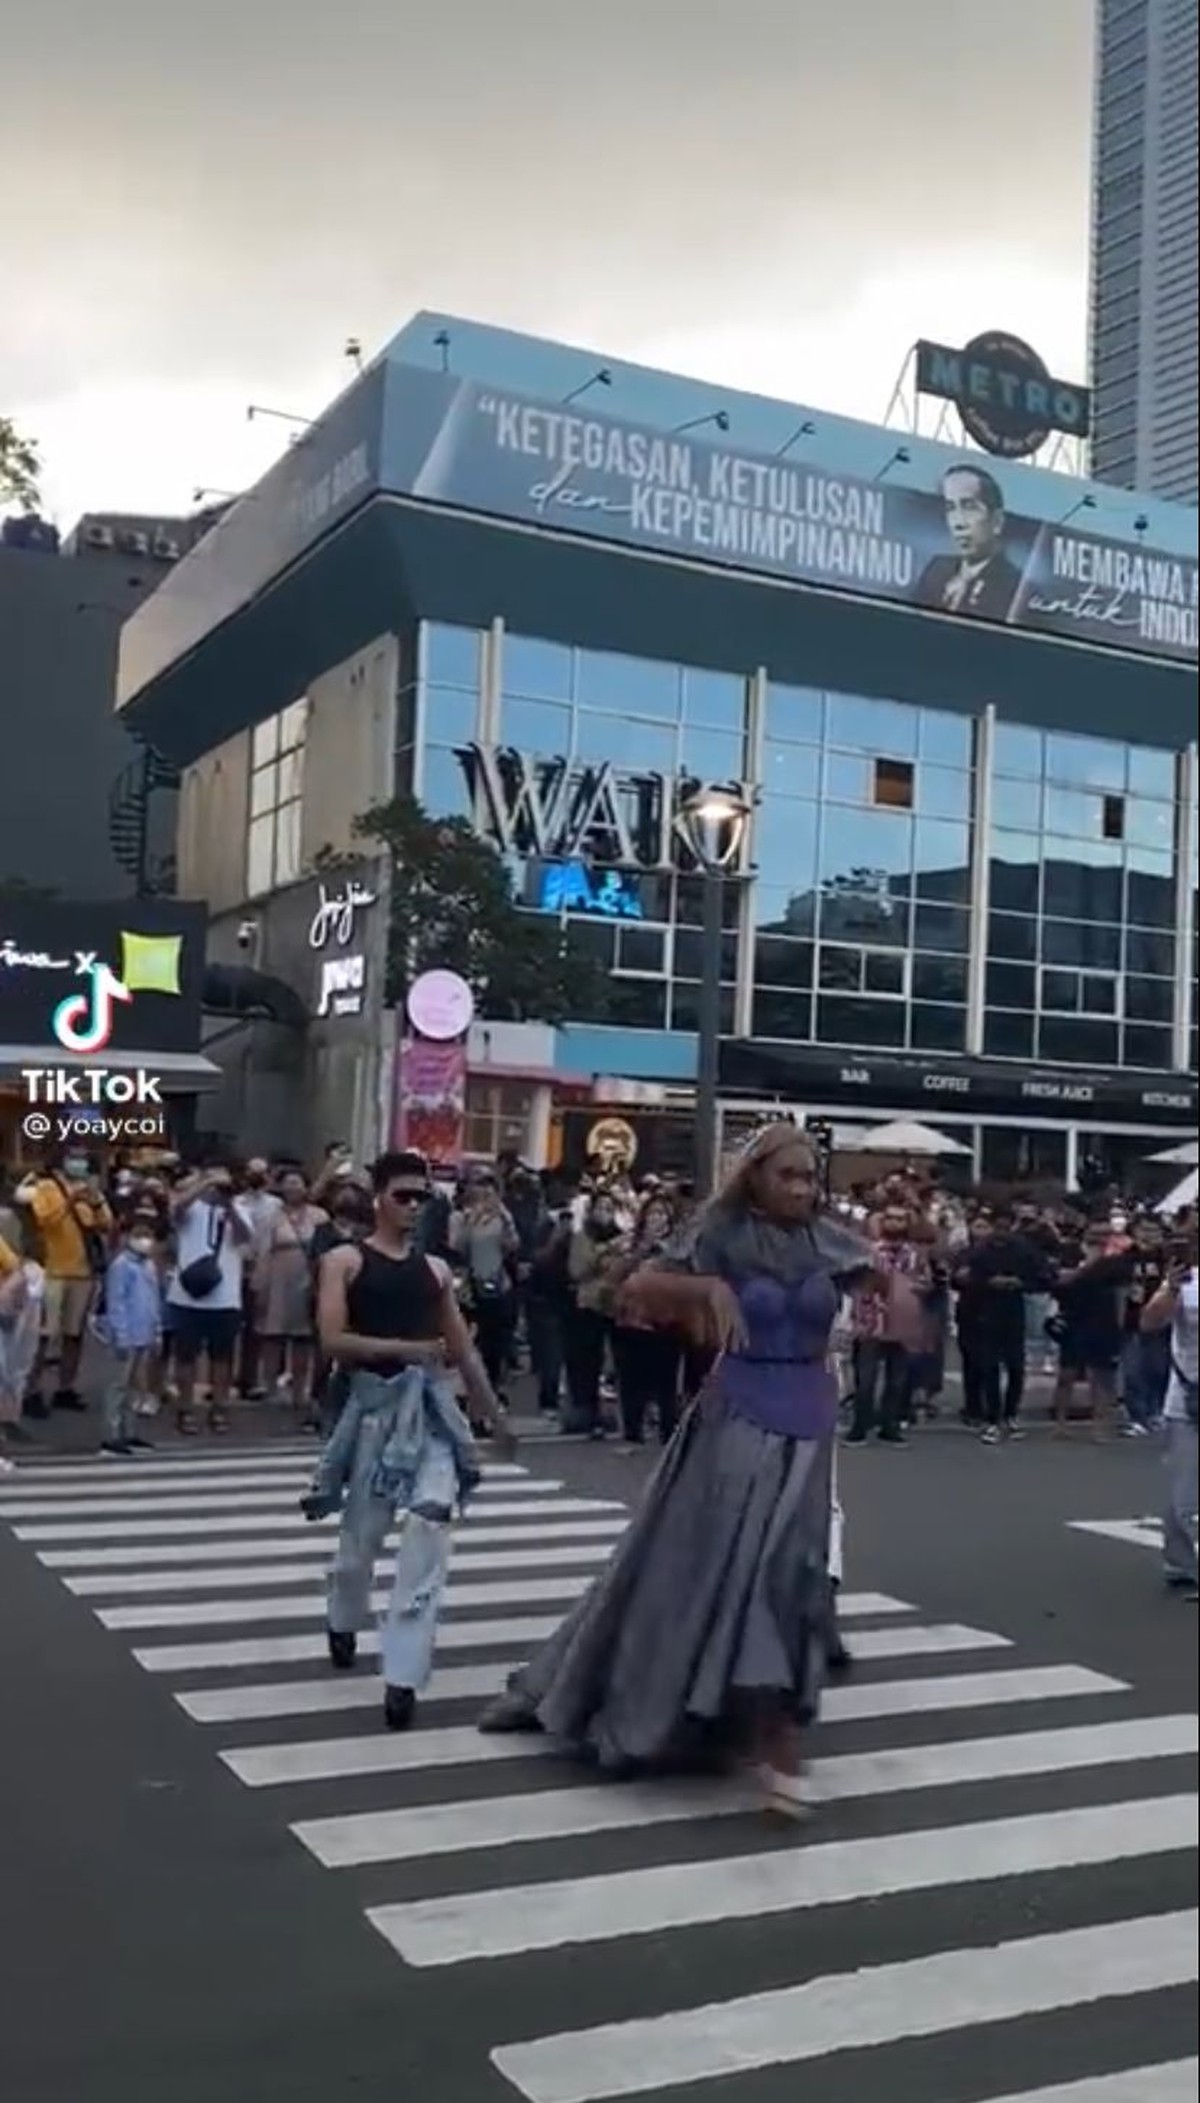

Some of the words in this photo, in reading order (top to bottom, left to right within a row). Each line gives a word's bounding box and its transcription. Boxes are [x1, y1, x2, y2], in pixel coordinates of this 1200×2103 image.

[930, 352, 1080, 425] METRO
[710, 452, 884, 535] KETULUSAN
[528, 462, 633, 515] dan
[632, 482, 913, 587] KEPEMIMPINANMU
[1053, 535, 1184, 604] MEMBAWA
[1028, 584, 1141, 627] untuk
[840, 1068, 871, 1084] BAR
[923, 1075, 970, 1092] COFFEE
[1022, 1082, 1060, 1098] FRESH
